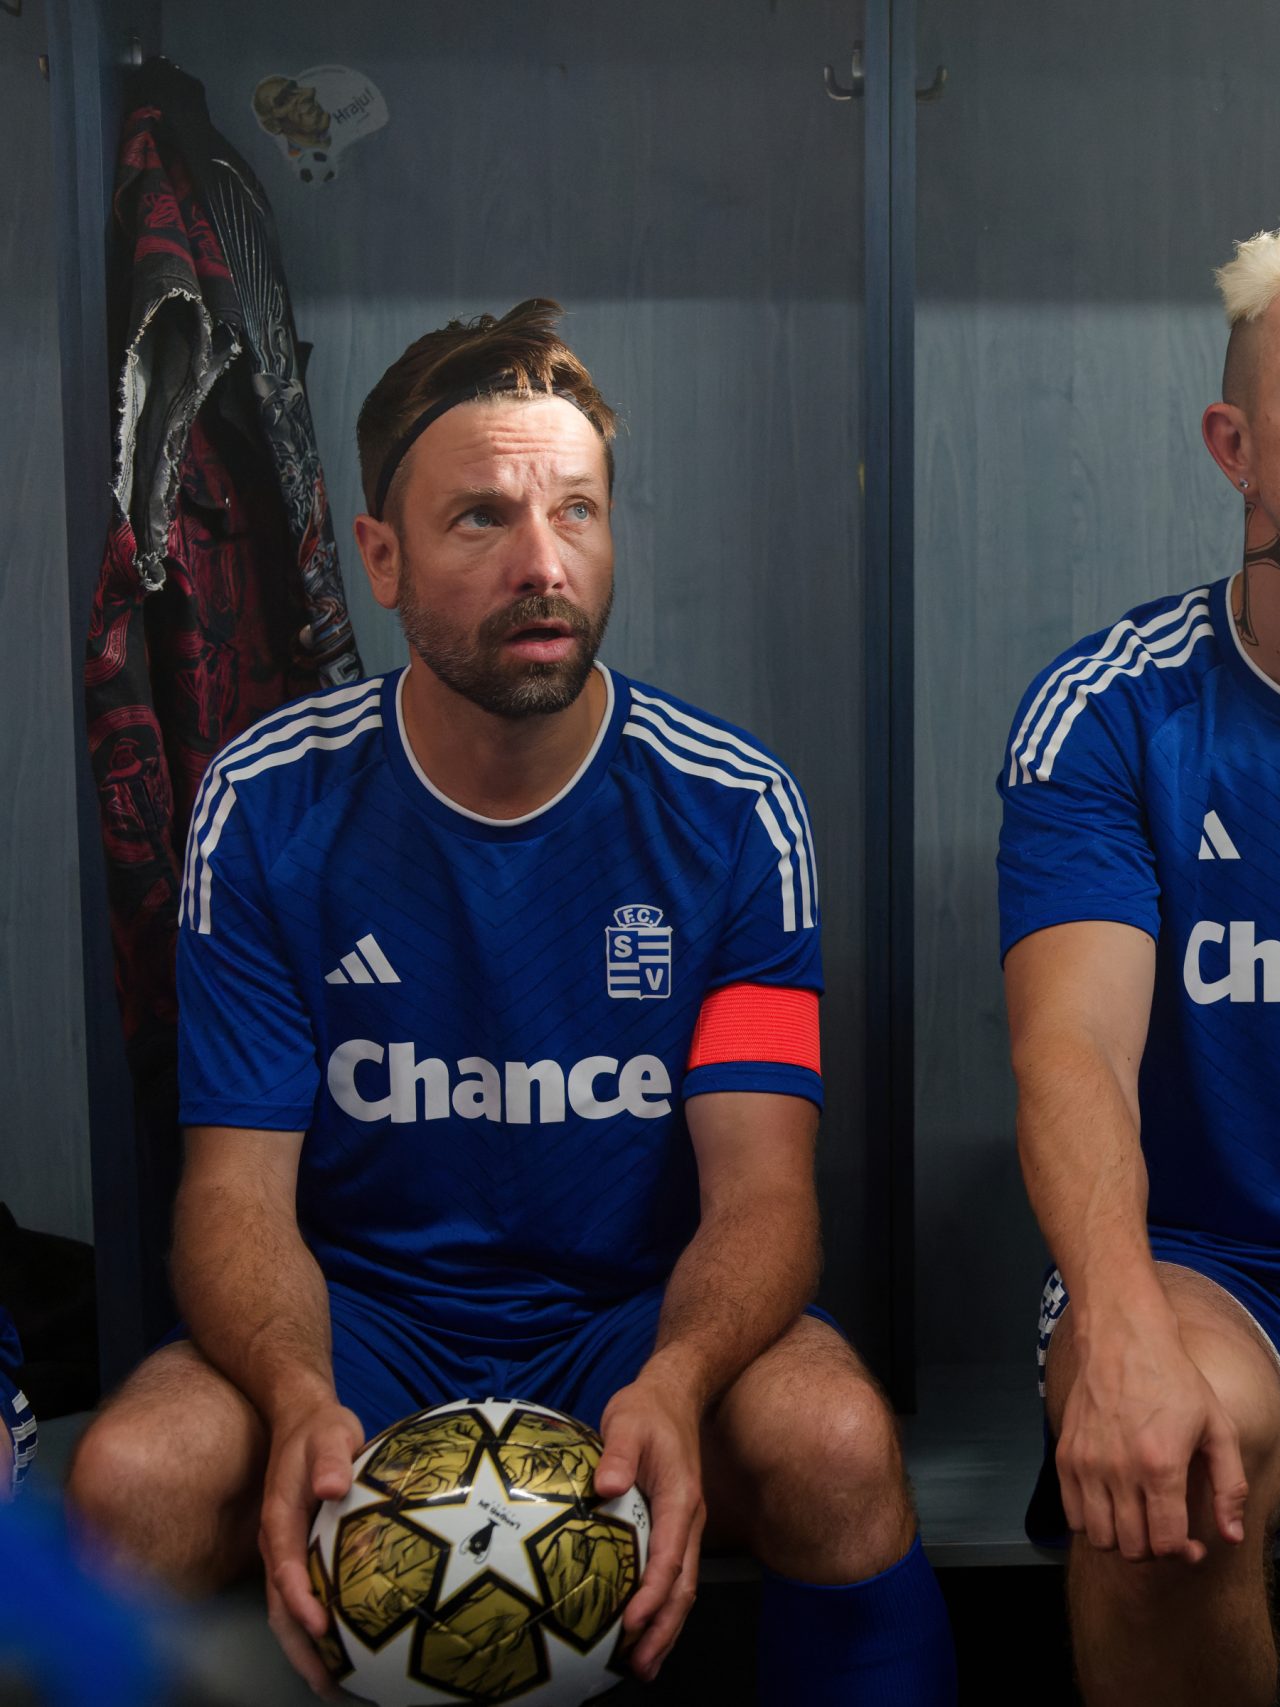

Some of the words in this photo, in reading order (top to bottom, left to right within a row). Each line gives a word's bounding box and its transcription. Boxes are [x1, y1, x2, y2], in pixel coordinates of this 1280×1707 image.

[623, 908, 654, 924] F.C.
[614, 934, 633, 958] S
[645, 967, 664, 991] V
[328, 1040, 671, 1123] Chance
